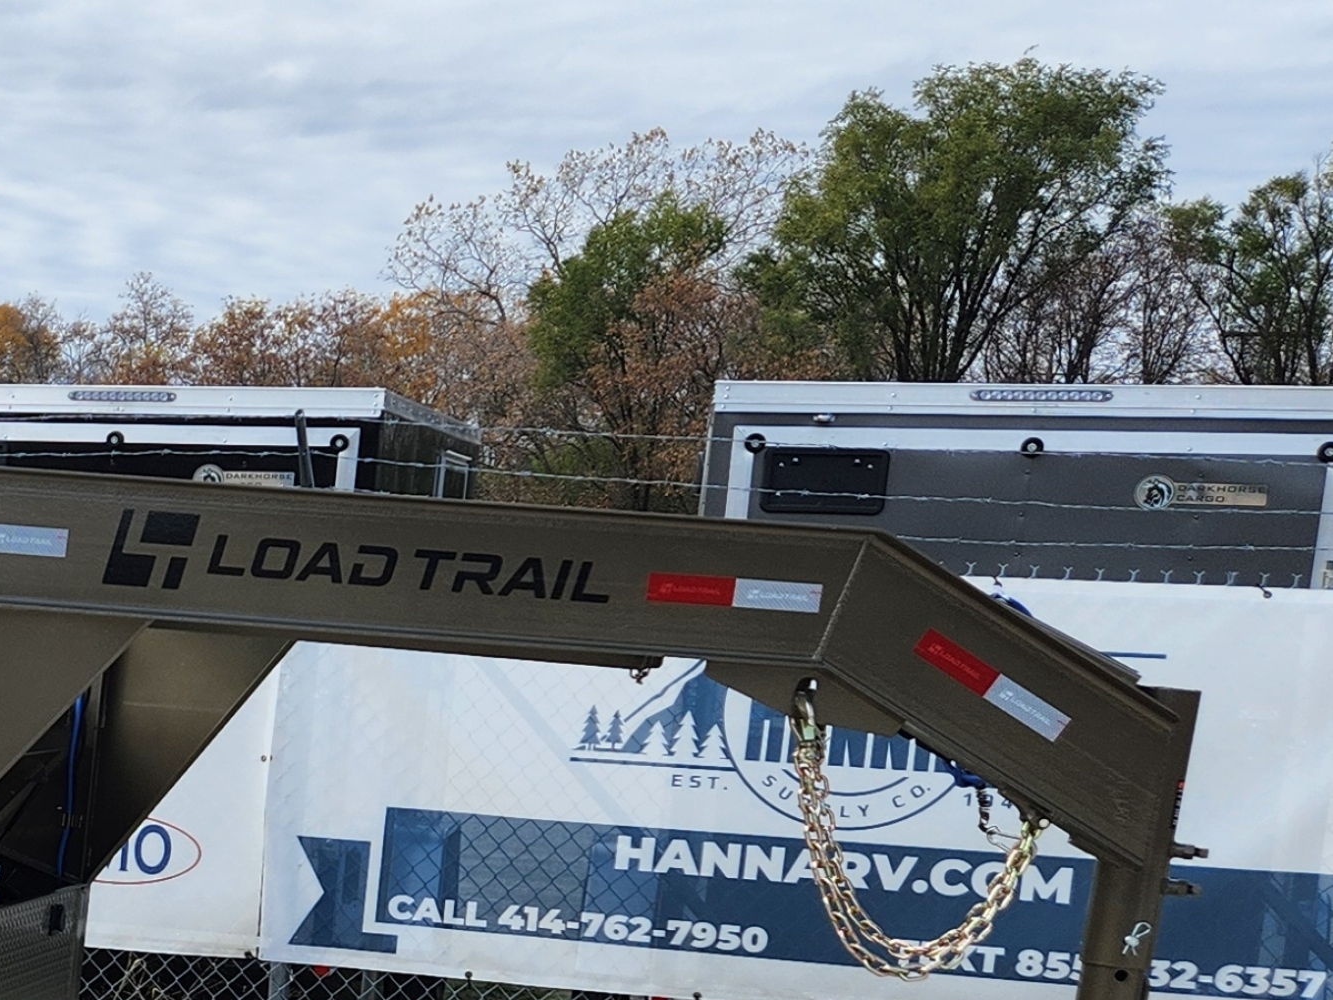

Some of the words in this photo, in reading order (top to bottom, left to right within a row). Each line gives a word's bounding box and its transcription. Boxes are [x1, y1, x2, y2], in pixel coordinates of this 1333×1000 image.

[225, 472, 294, 480] DARKHORSE
[1175, 494, 1225, 503] CARGO
[1177, 484, 1266, 494] DARKHORSE
[206, 534, 399, 588] LOAD
[413, 548, 611, 604] TRAIL
[670, 774, 729, 791] EST.
[891, 784, 932, 809] CO.
[613, 834, 1075, 905] HANNARV.COM
[387, 895, 488, 928] CALL
[497, 904, 769, 954] 414-762-7950
